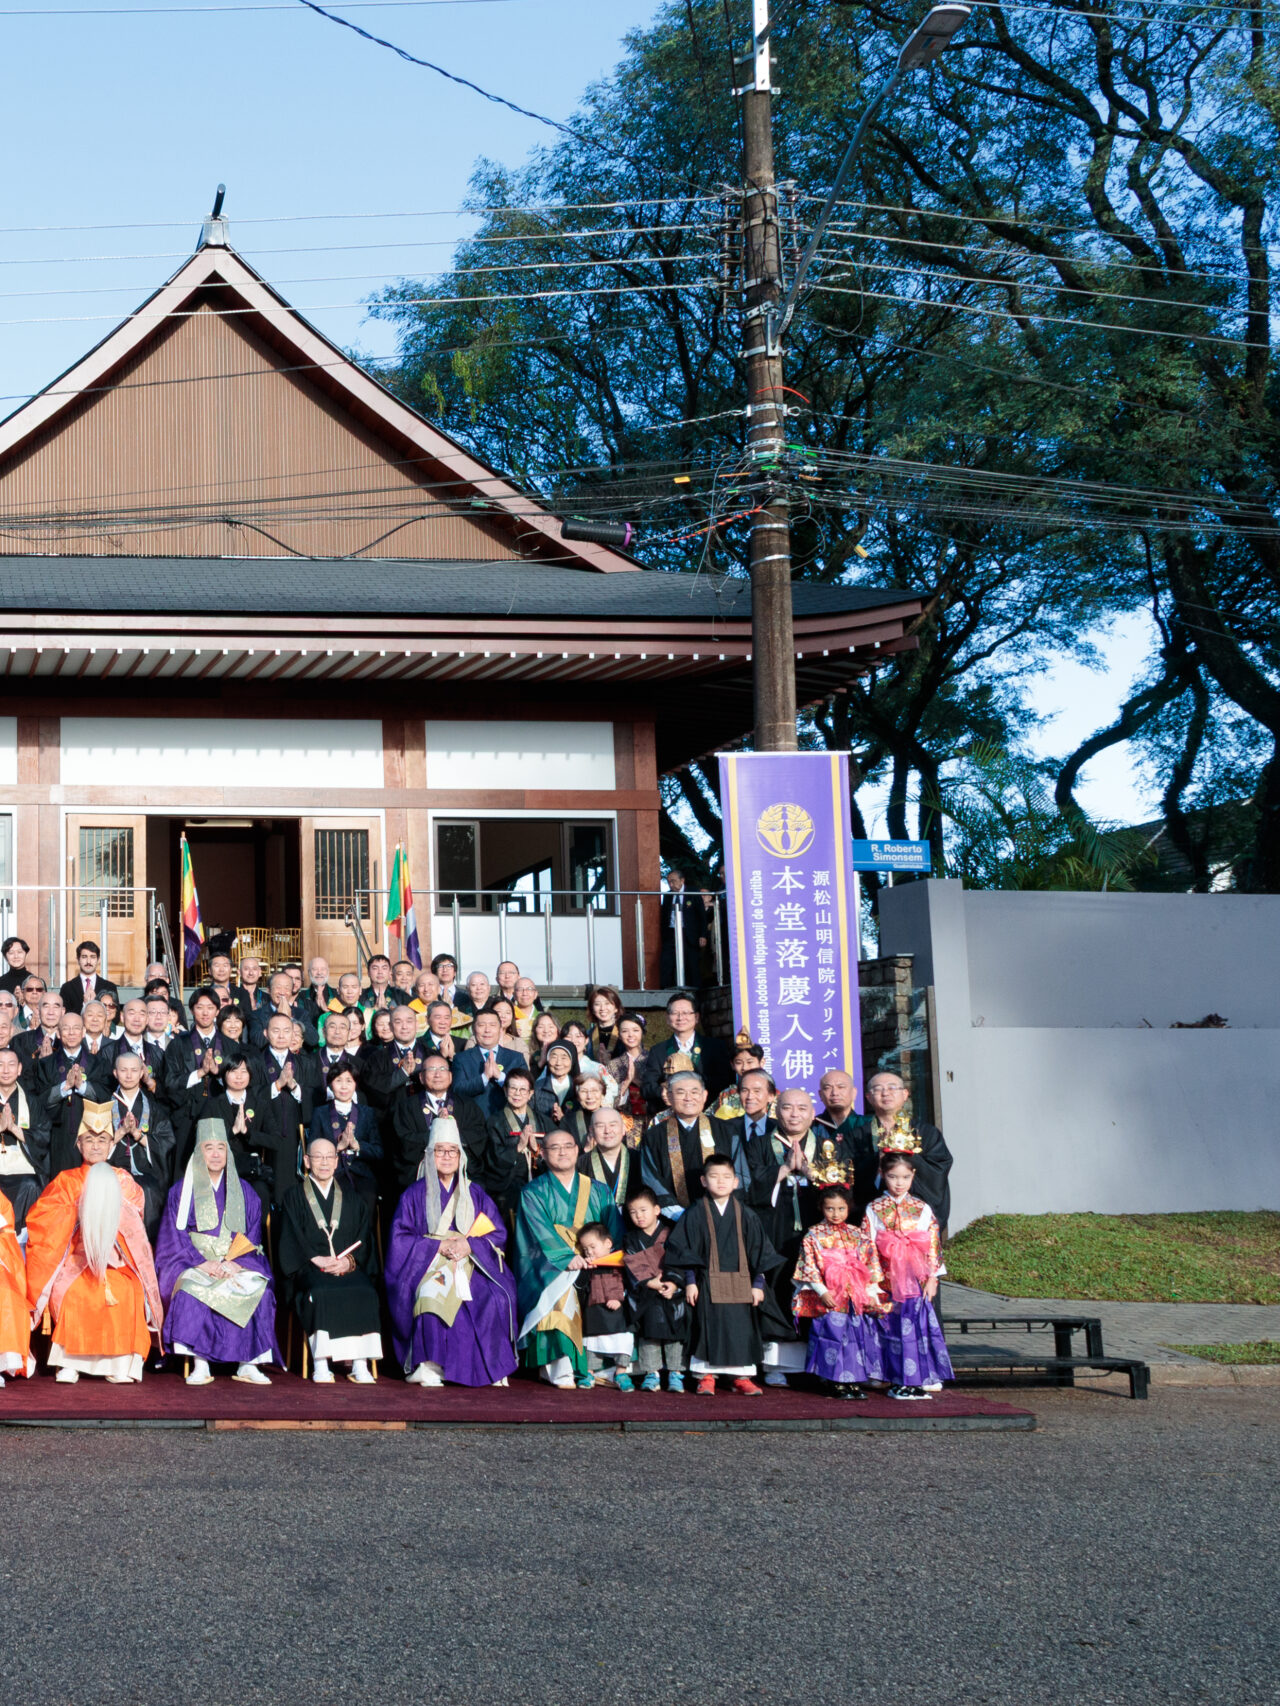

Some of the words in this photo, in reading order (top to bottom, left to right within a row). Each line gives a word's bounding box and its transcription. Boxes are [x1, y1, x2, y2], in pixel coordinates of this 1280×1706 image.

[871, 844, 881, 852] R.
[884, 844, 922, 853] Roberto
[749, 870, 763, 907] Curitiba
[751, 908, 764, 920] de
[752, 922, 768, 965] Nippakuji
[754, 967, 769, 1007] Jodoshu
[771, 865, 817, 1103] 本堂落慶入佛
[757, 1009, 771, 1045] Budista
